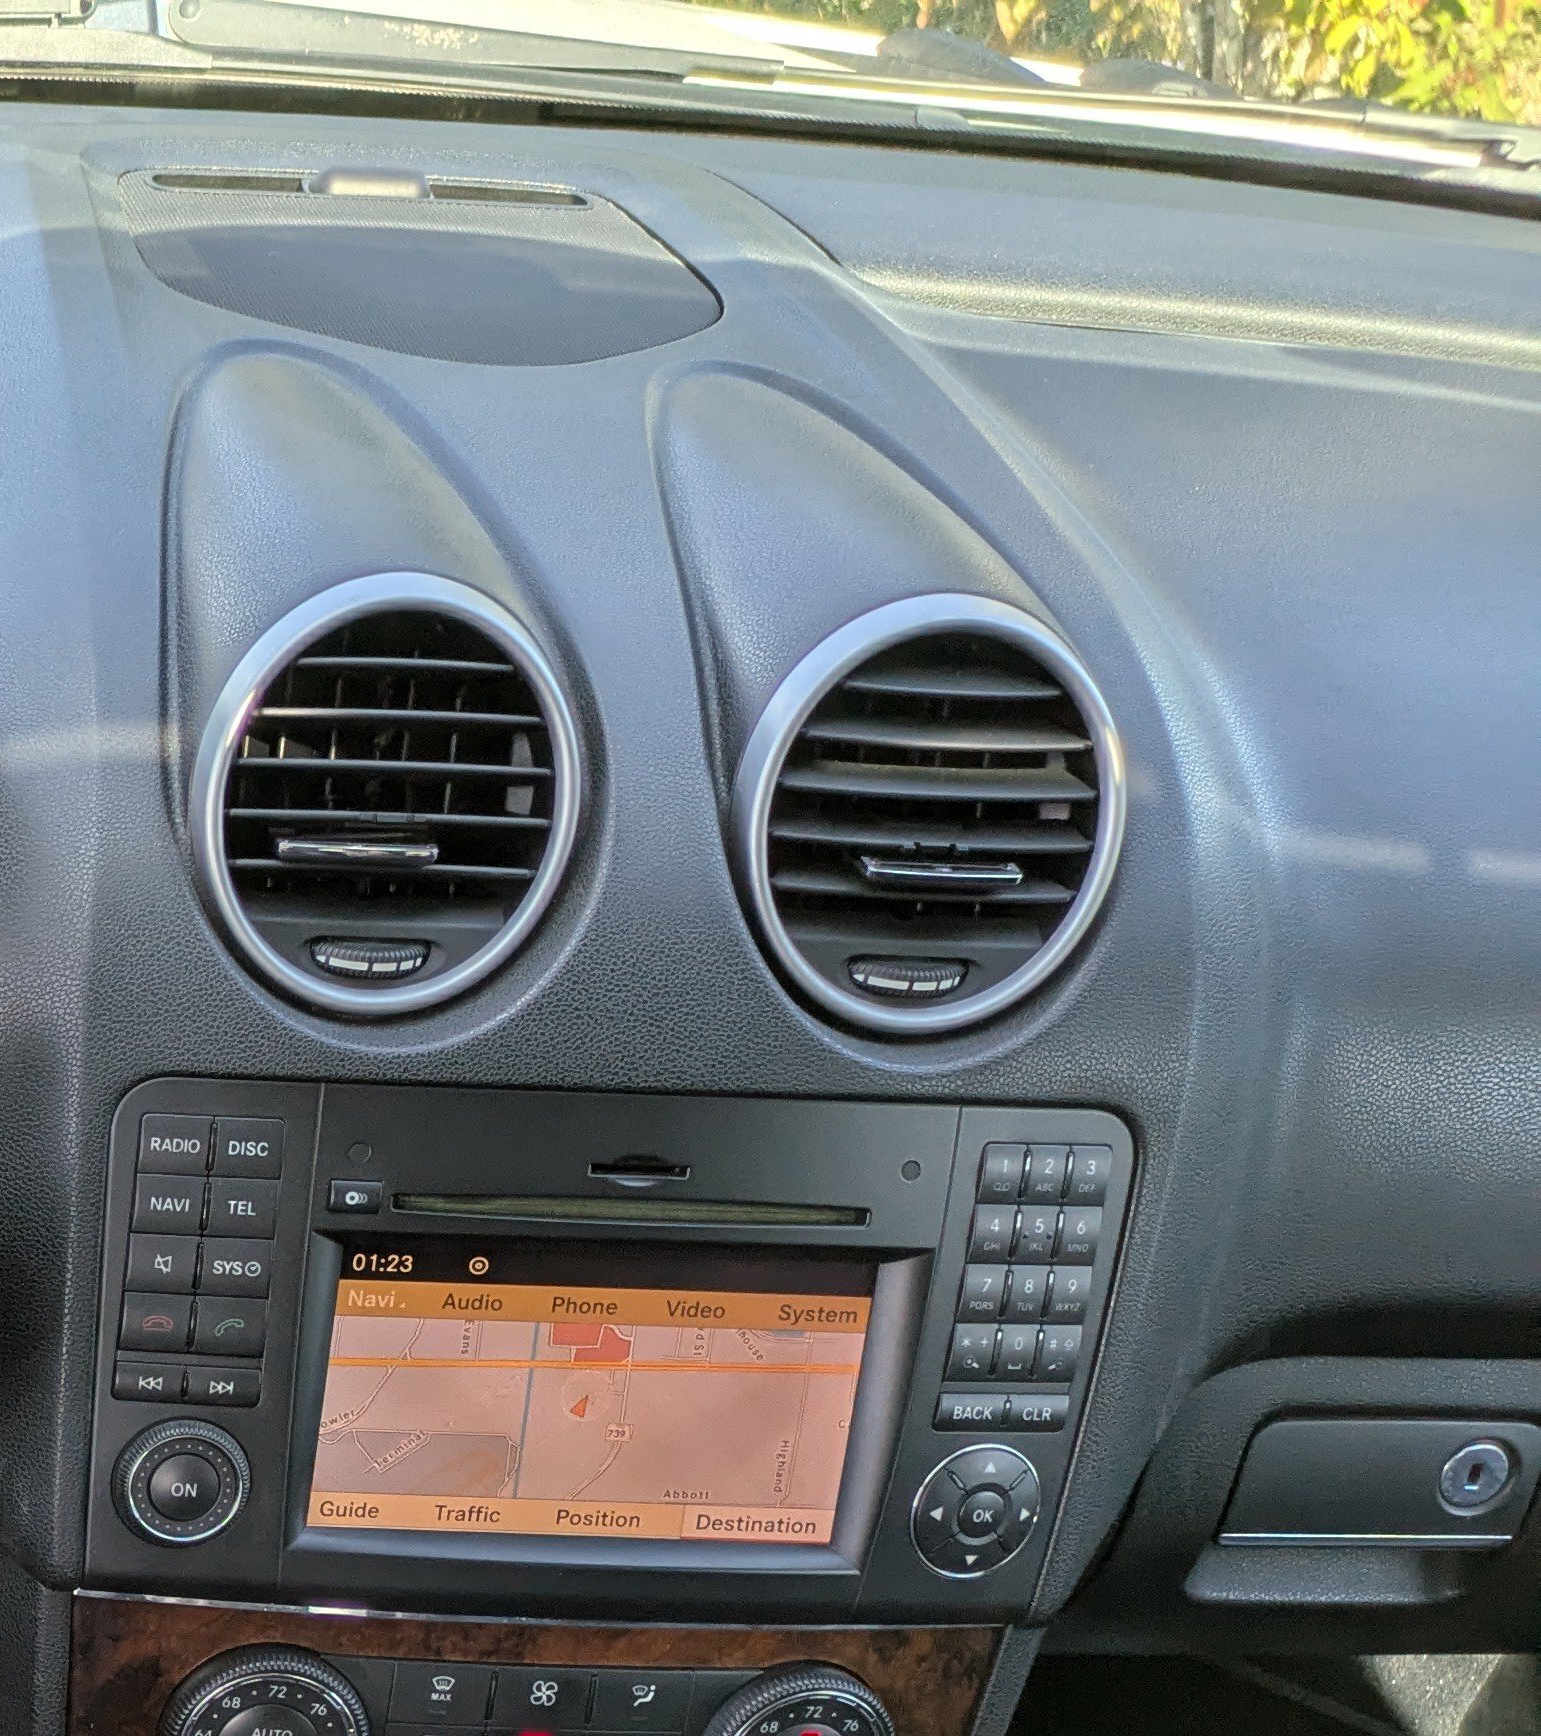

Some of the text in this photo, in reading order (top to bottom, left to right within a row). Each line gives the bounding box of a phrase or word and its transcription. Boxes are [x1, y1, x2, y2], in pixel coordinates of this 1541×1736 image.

[150, 1138, 201, 1155] RADIO
[227, 1140, 269, 1157] DISC
[1002, 1158, 1009, 1174] 1
[1044, 1158, 1055, 1175] 2
[1086, 1160, 1096, 1175] 3
[149, 1197, 190, 1213] NAVI
[227, 1200, 257, 1217] TEL
[989, 1218, 1000, 1234] 4
[1034, 1218, 1045, 1234] 5
[1076, 1220, 1086, 1235] 6
[212, 1260, 243, 1276] SYS
[352, 1254, 414, 1273] 01:23
[982, 1278, 992, 1293] 7
[1024, 1278, 1035, 1294] 8
[1067, 1278, 1078, 1294] 9
[347, 1289, 397, 1309] Navi
[441, 1293, 503, 1313] Audio
[551, 1296, 617, 1317] Phone
[665, 1300, 726, 1320] Video
[778, 1303, 859, 1325] System
[1014, 1337, 1024, 1351] 0
[952, 1406, 993, 1420] BACK
[1022, 1407, 1052, 1421] CLR
[170, 1482, 198, 1499] ON
[319, 1501, 380, 1520] Guide
[434, 1504, 501, 1524] Traffic
[554, 1508, 642, 1528] Position
[972, 1508, 994, 1524] OK
[695, 1513, 817, 1535] Destination
[268, 1685, 287, 1699] 72
[431, 1693, 452, 1701] MAX
[221, 1697, 241, 1709] 68
[309, 1703, 328, 1716] 76
[804, 1706, 823, 1718] 72
[760, 1721, 779, 1734] 68
[842, 1719, 859, 1732] 76
